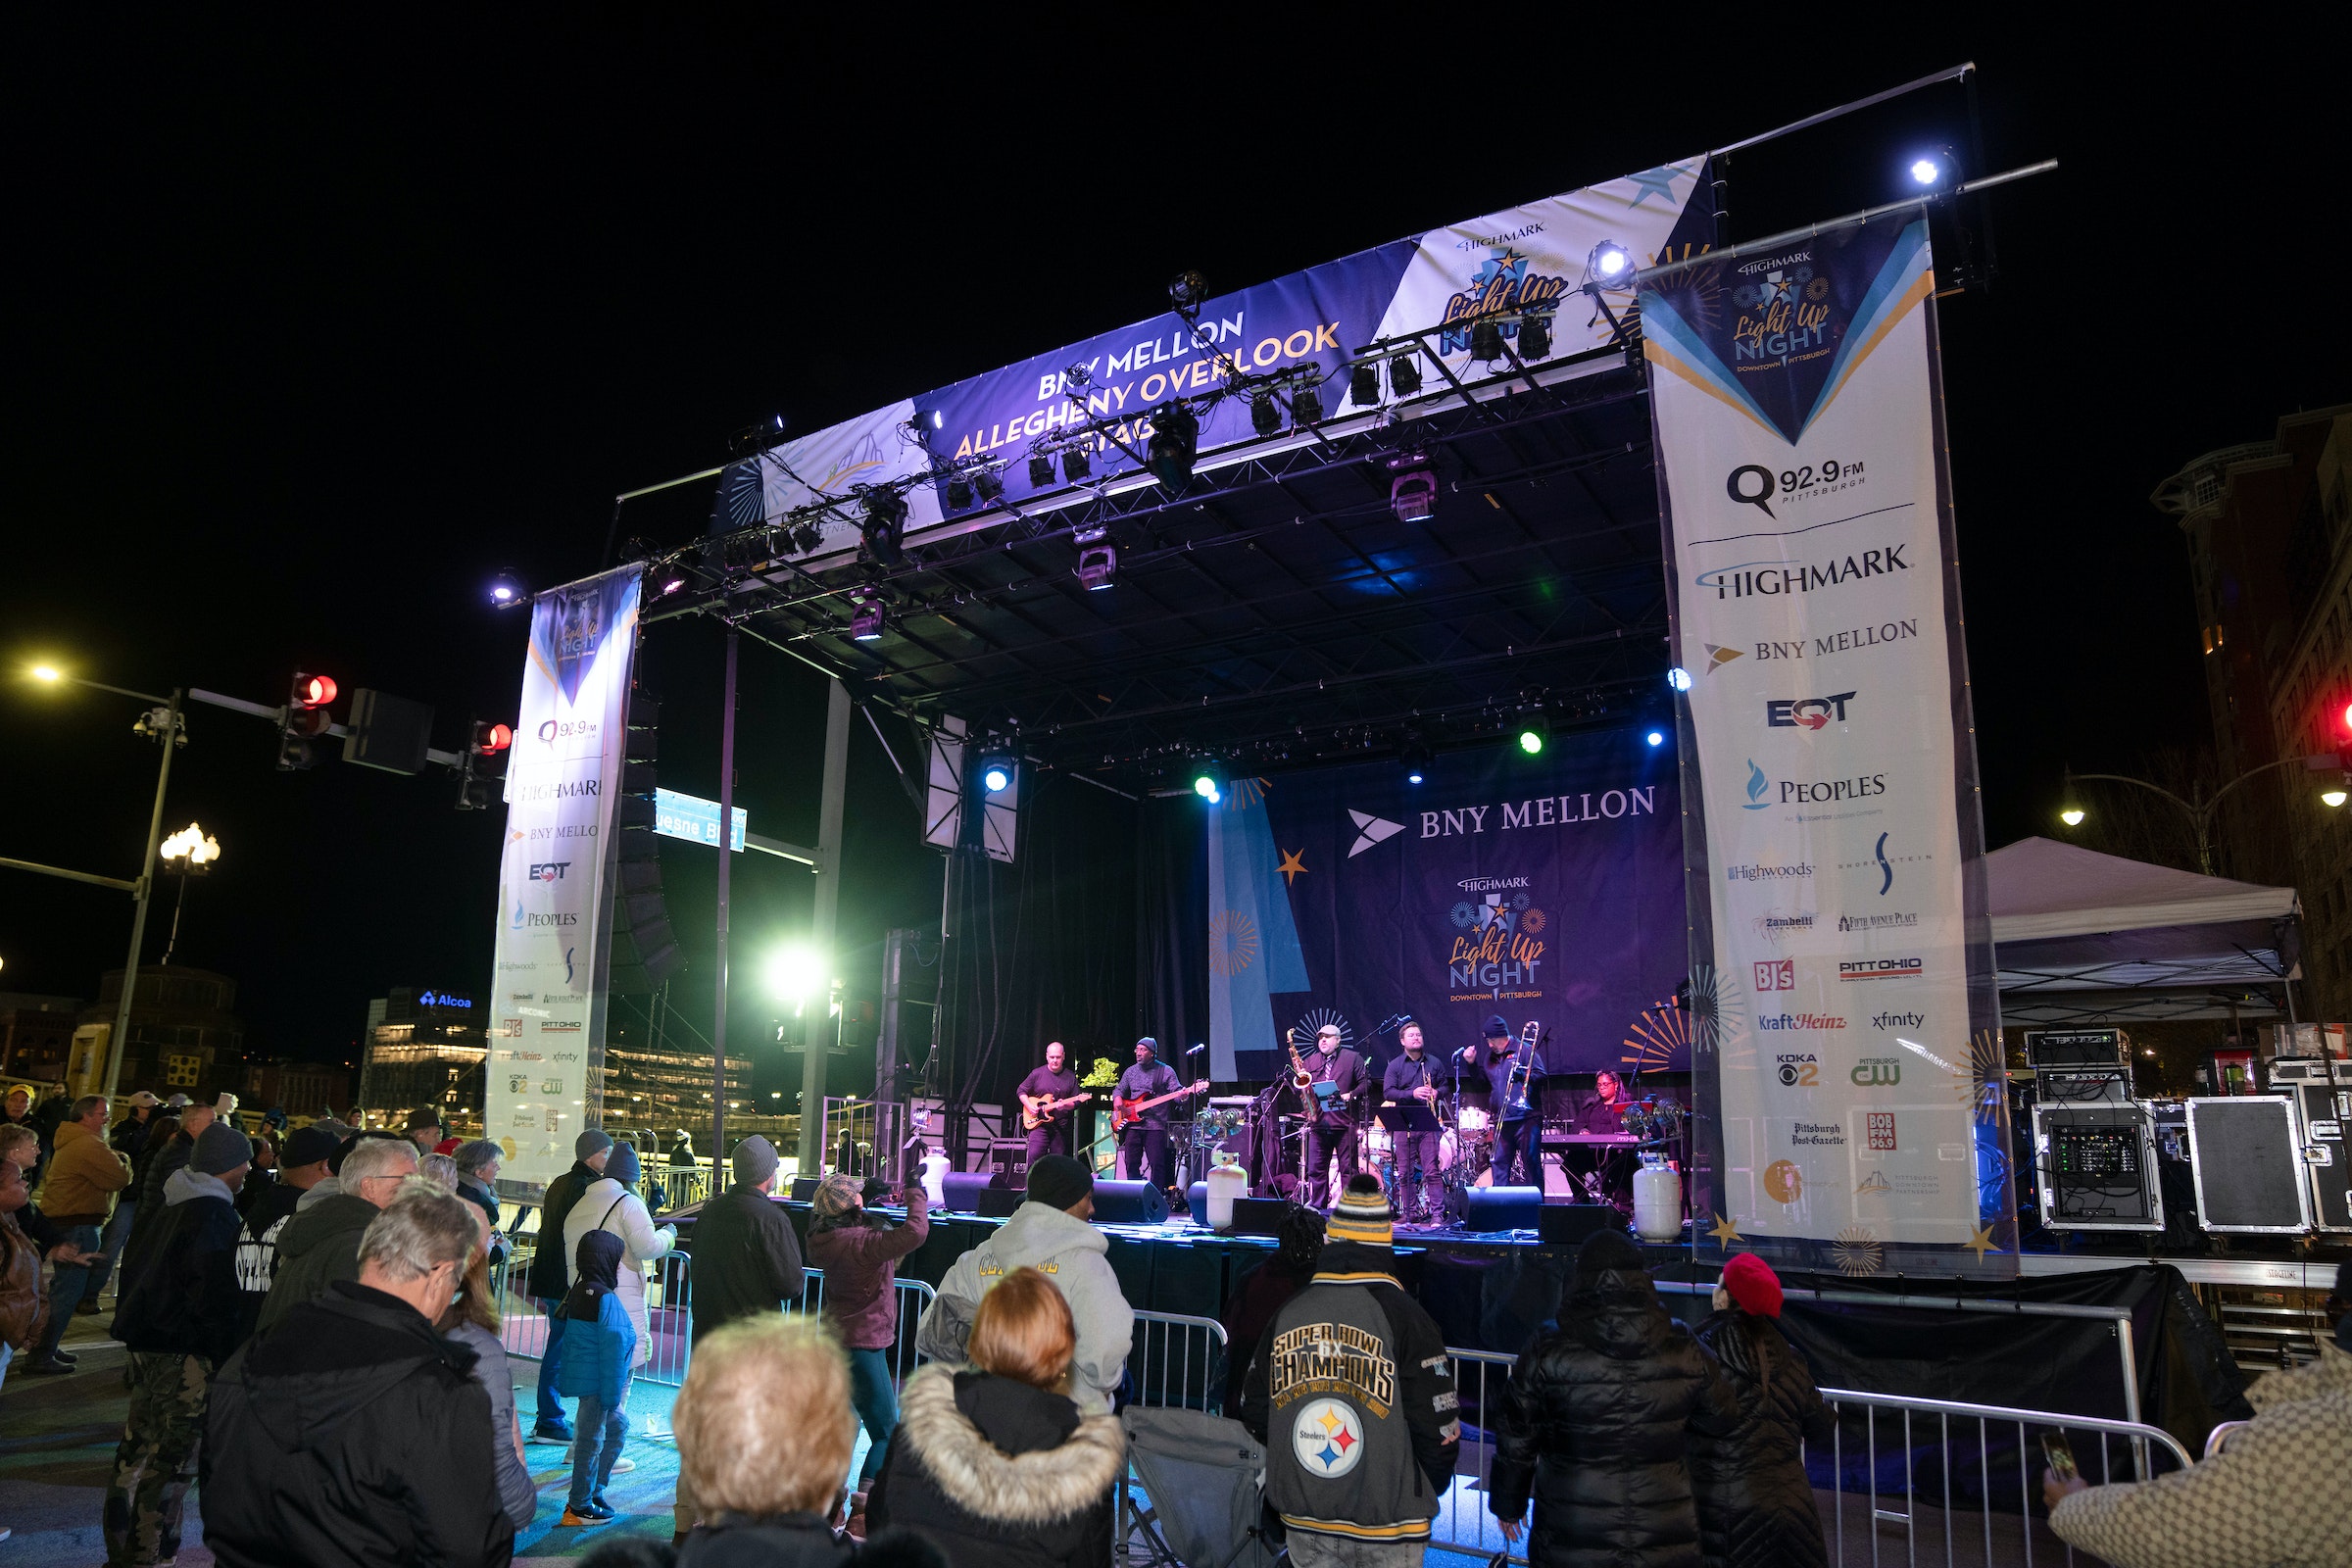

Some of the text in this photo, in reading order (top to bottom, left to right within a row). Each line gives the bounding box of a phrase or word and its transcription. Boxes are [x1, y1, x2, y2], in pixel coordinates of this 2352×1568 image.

[1460, 221, 1546, 252] HIGHMARK
[1740, 252, 1812, 275] HIGHMARK
[1734, 301, 1831, 348] Light Up
[1106, 312, 1244, 379] MELLON
[1735, 322, 1827, 360] NIGHT
[1737, 348, 1831, 372] DOWNTOWN PITTSBURGH
[954, 321, 1340, 462] ALLEGHENY OVERLOOK
[1079, 416, 1155, 458] STAG
[1727, 460, 1865, 520] Q 92.9 FM
[1783, 477, 1865, 504] PITTSBURGH
[1718, 544, 1909, 600] HIGHMARK
[1755, 618, 1918, 661] BNY MELLON
[1766, 690, 1858, 731] EQT
[538, 719, 558, 751] Q
[560, 720, 587, 736] 92.9
[1779, 773, 1886, 804] PEOPLES
[1420, 785, 1655, 838] BNY MELLON
[530, 825, 599, 840] BNY MELLO
[656, 813, 738, 843] uesne Bld
[529, 862, 572, 882] EQT
[1735, 861, 1813, 881] Highwoods
[1460, 876, 1530, 892] HIGHMARK
[528, 912, 578, 926] PEOPLES
[1766, 916, 1813, 927] Zambelli
[1894, 912, 1918, 924] PLACE
[1448, 927, 1545, 974] Light Up
[1450, 960, 1541, 988] NIGHT
[438, 995, 472, 1008] Alcoa
[1450, 991, 1543, 1002] DOWNTOWN PITTSBURGH
[1873, 1011, 1924, 1030] xfinity
[553, 1052, 578, 1063] xfinity
[1777, 1054, 1817, 1063] KDKA
[518, 1080, 527, 1094] 2
[1798, 1063, 1901, 1087] 2 CW
[1794, 1114, 1892, 1134] Pittsburgh BOB
[1791, 1128, 1892, 1146] Post-Gazette FM
[1870, 1138, 1893, 1149] 96.9
[1274, 1322, 1388, 1363] SUPER BOWL
[1270, 1350, 1395, 1405] CHAMPIONS
[1299, 1430, 1326, 1441] Steelers
